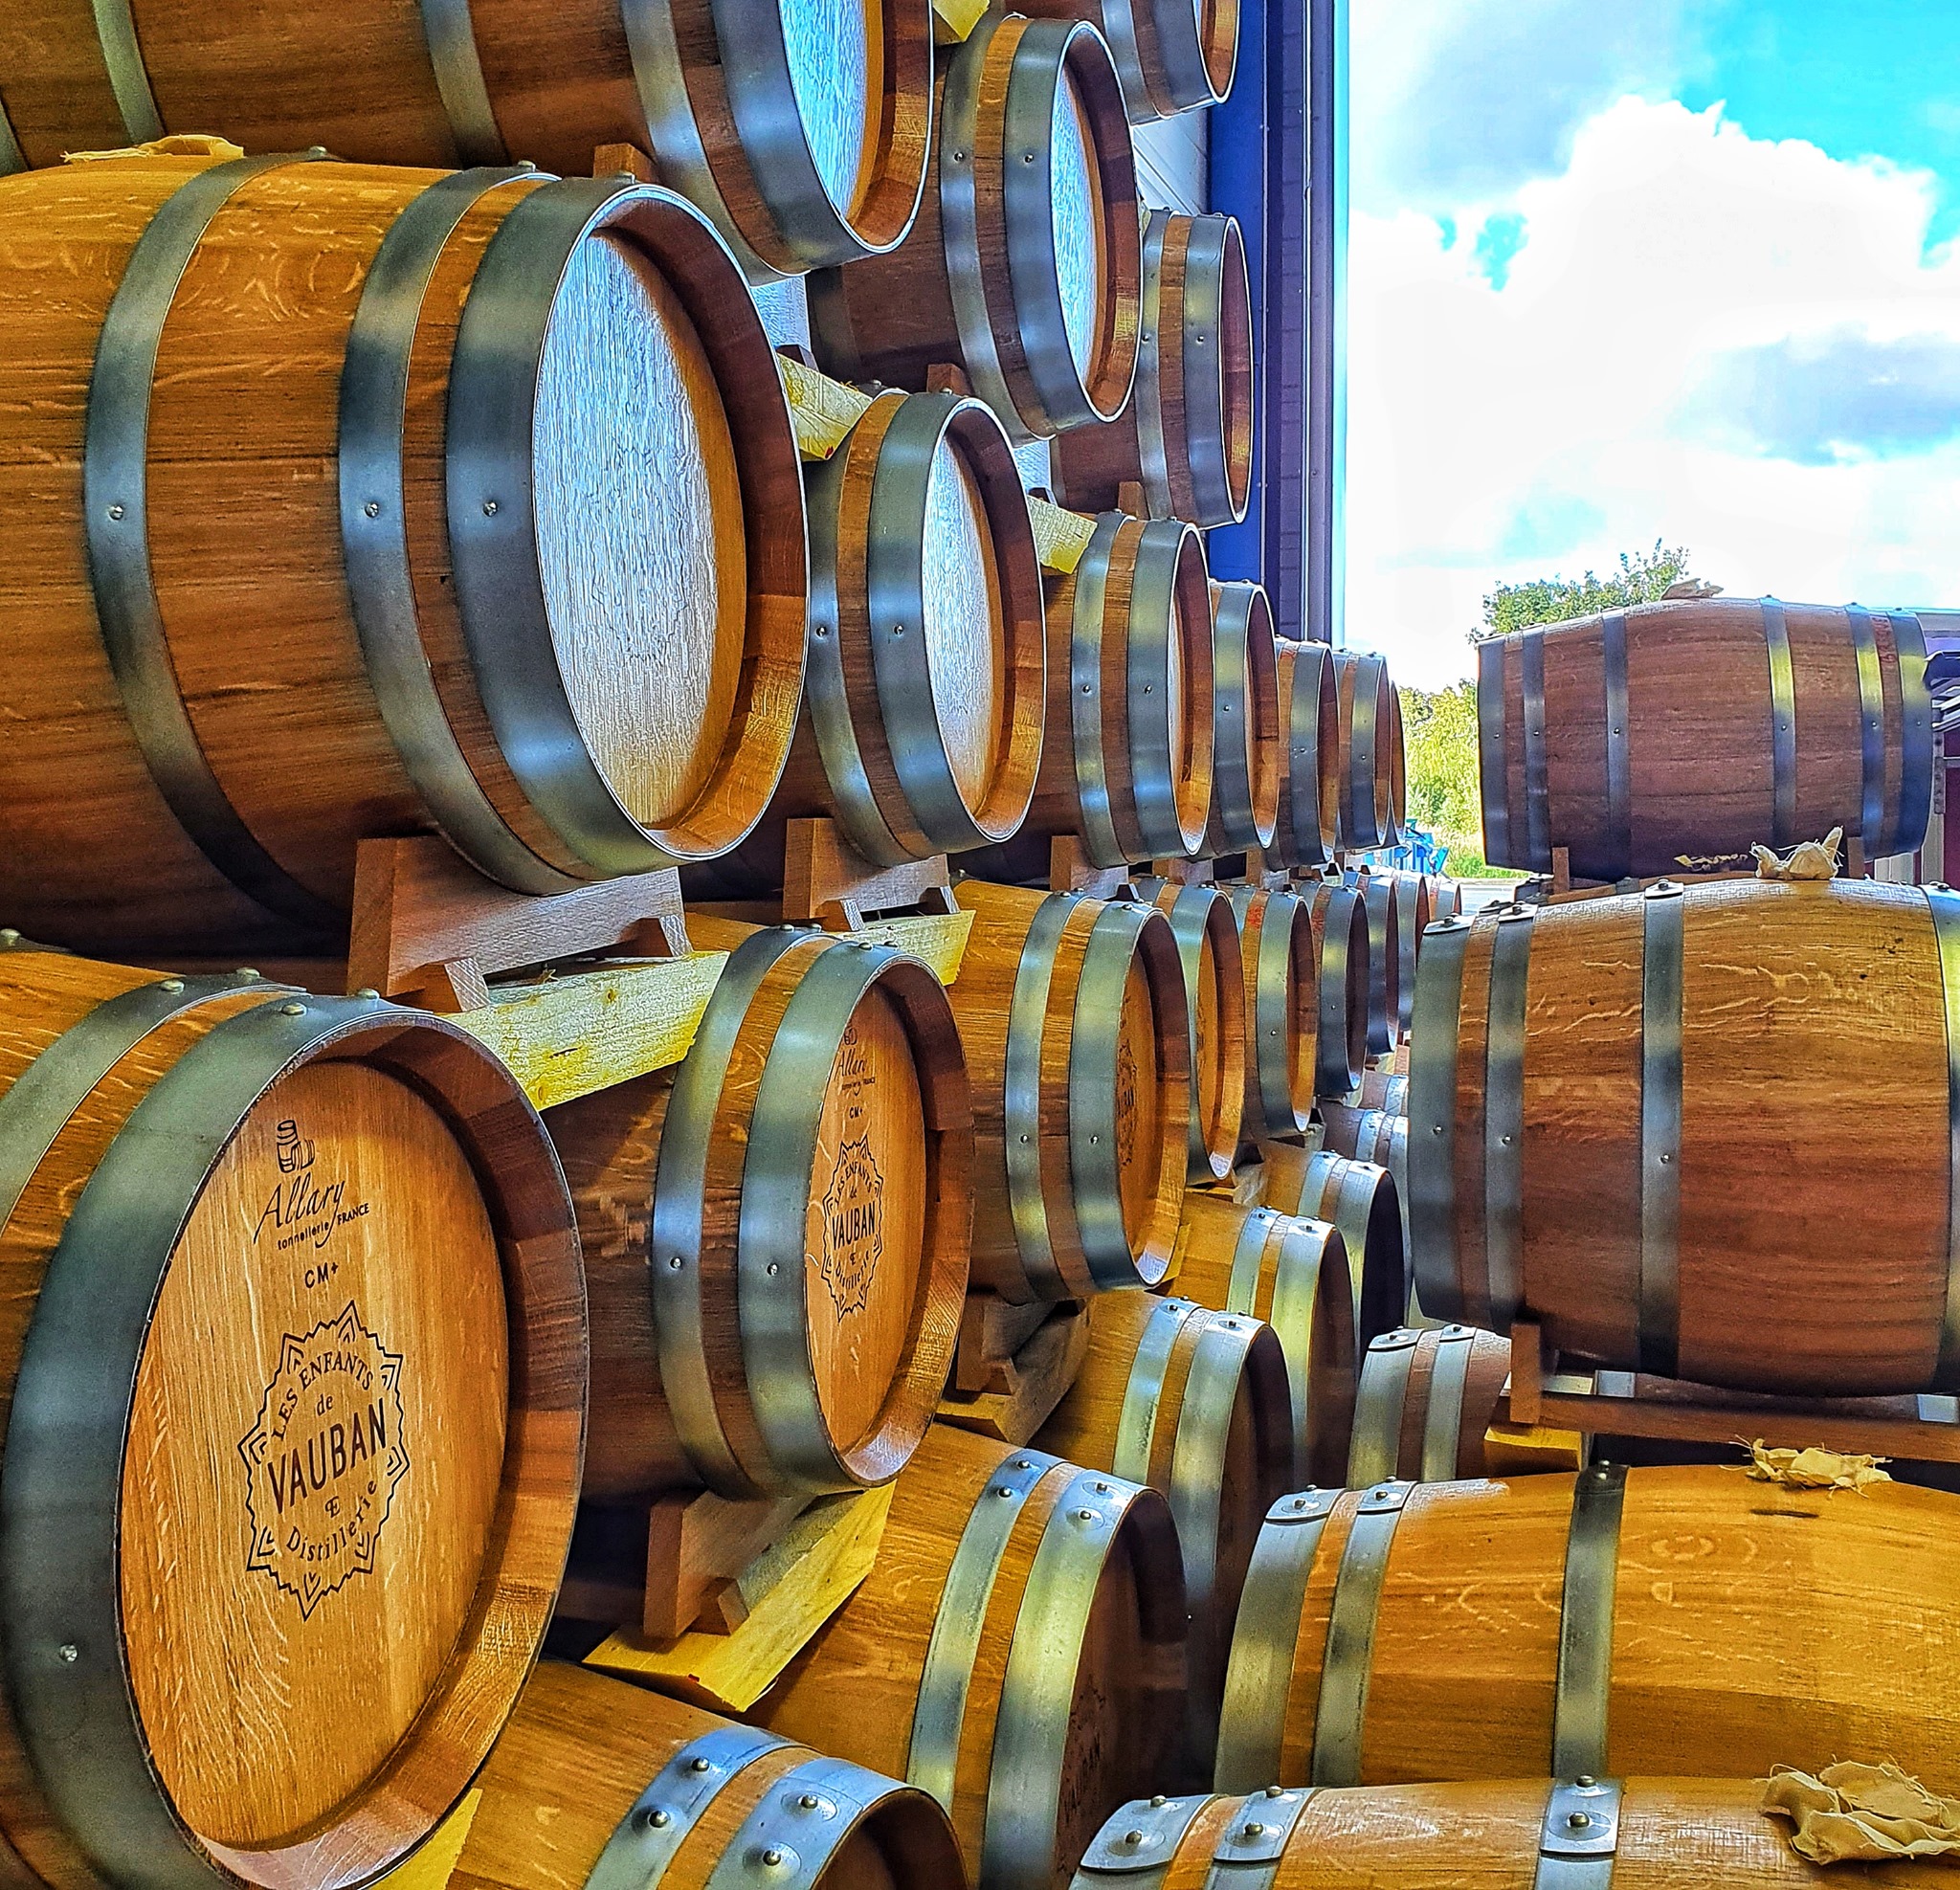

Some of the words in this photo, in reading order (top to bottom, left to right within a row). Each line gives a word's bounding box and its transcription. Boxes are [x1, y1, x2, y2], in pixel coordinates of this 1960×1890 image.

[254, 1171, 345, 1248] Allary
[278, 1221, 329, 1250] tonnellerie
[337, 1203, 369, 1226] FRANCE
[832, 1201, 875, 1251] VAUBAN
[304, 1261, 339, 1288] CM+
[272, 1388, 299, 1441] LES
[299, 1351, 373, 1391] ENFANTS
[316, 1393, 333, 1416] de
[267, 1397, 386, 1515] VAUBAN
[286, 1479, 377, 1562] Distillerie
